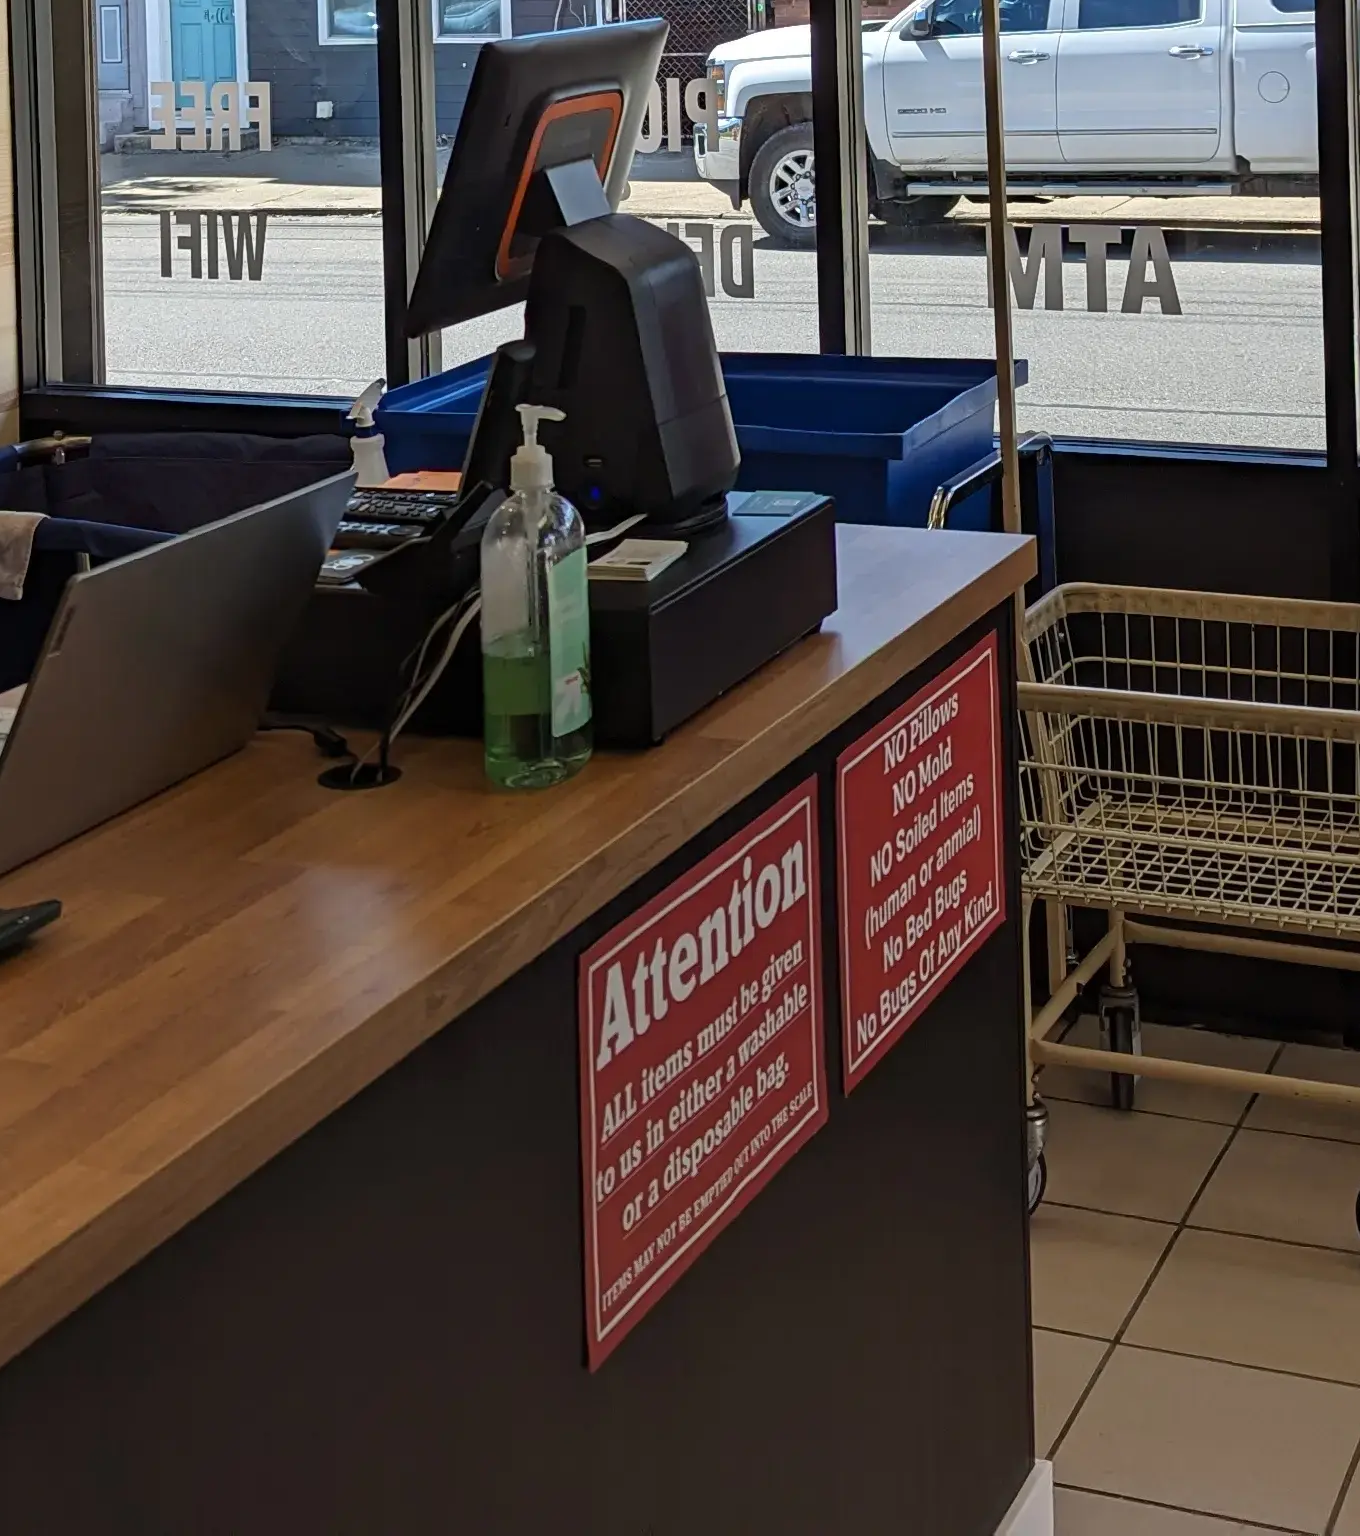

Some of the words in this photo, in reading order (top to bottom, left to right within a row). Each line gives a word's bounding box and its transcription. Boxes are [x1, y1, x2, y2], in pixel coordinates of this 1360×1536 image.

[883, 728, 907, 776] NO
[909, 692, 959, 753] Pillows
[892, 769, 916, 817] NO
[917, 736, 953, 795] Mold
[865, 874, 917, 950] (human
[919, 855, 934, 887] or
[870, 840, 892, 888] NO
[896, 798, 937, 862] Soiled
[940, 773, 974, 822] Items
[596, 839, 806, 1072] Attention
[856, 1012, 877, 1052] No
[879, 970, 917, 1026] Bugs
[919, 940, 935, 982] Of
[937, 920, 962, 965] Any
[964, 880, 993, 935] Kind
[883, 935, 903, 974] No
[906, 896, 933, 950] Bed
[935, 869, 968, 920] Bugs
[596, 1166, 616, 1203] to
[619, 1139, 642, 1180] us
[646, 1119, 665, 1156] in
[668, 1067, 724, 1132] either
[726, 1054, 736, 1083] a
[738, 982, 808, 1068] washable
[601, 1082, 637, 1144] ALL
[641, 1040, 693, 1105] items
[697, 996, 738, 1057] must
[740, 980, 759, 1016] be
[761, 940, 803, 1003] given
[601, 1266, 633, 1312] ITEMS
[633, 1242, 656, 1277] MAY
[656, 1220, 677, 1255] NOT
[678, 1207, 693, 1233] BE
[693, 1166, 733, 1217] EMPTIED
[733, 1145, 749, 1175] OUT
[750, 1124, 771, 1157] INTO
[771, 1105, 789, 1134] THE
[789, 1081, 814, 1117] SCALE
[622, 1191, 644, 1231] or
[647, 1178, 660, 1208] a
[663, 1084, 754, 1192] disposable
[756, 1051, 790, 1100] bag.
